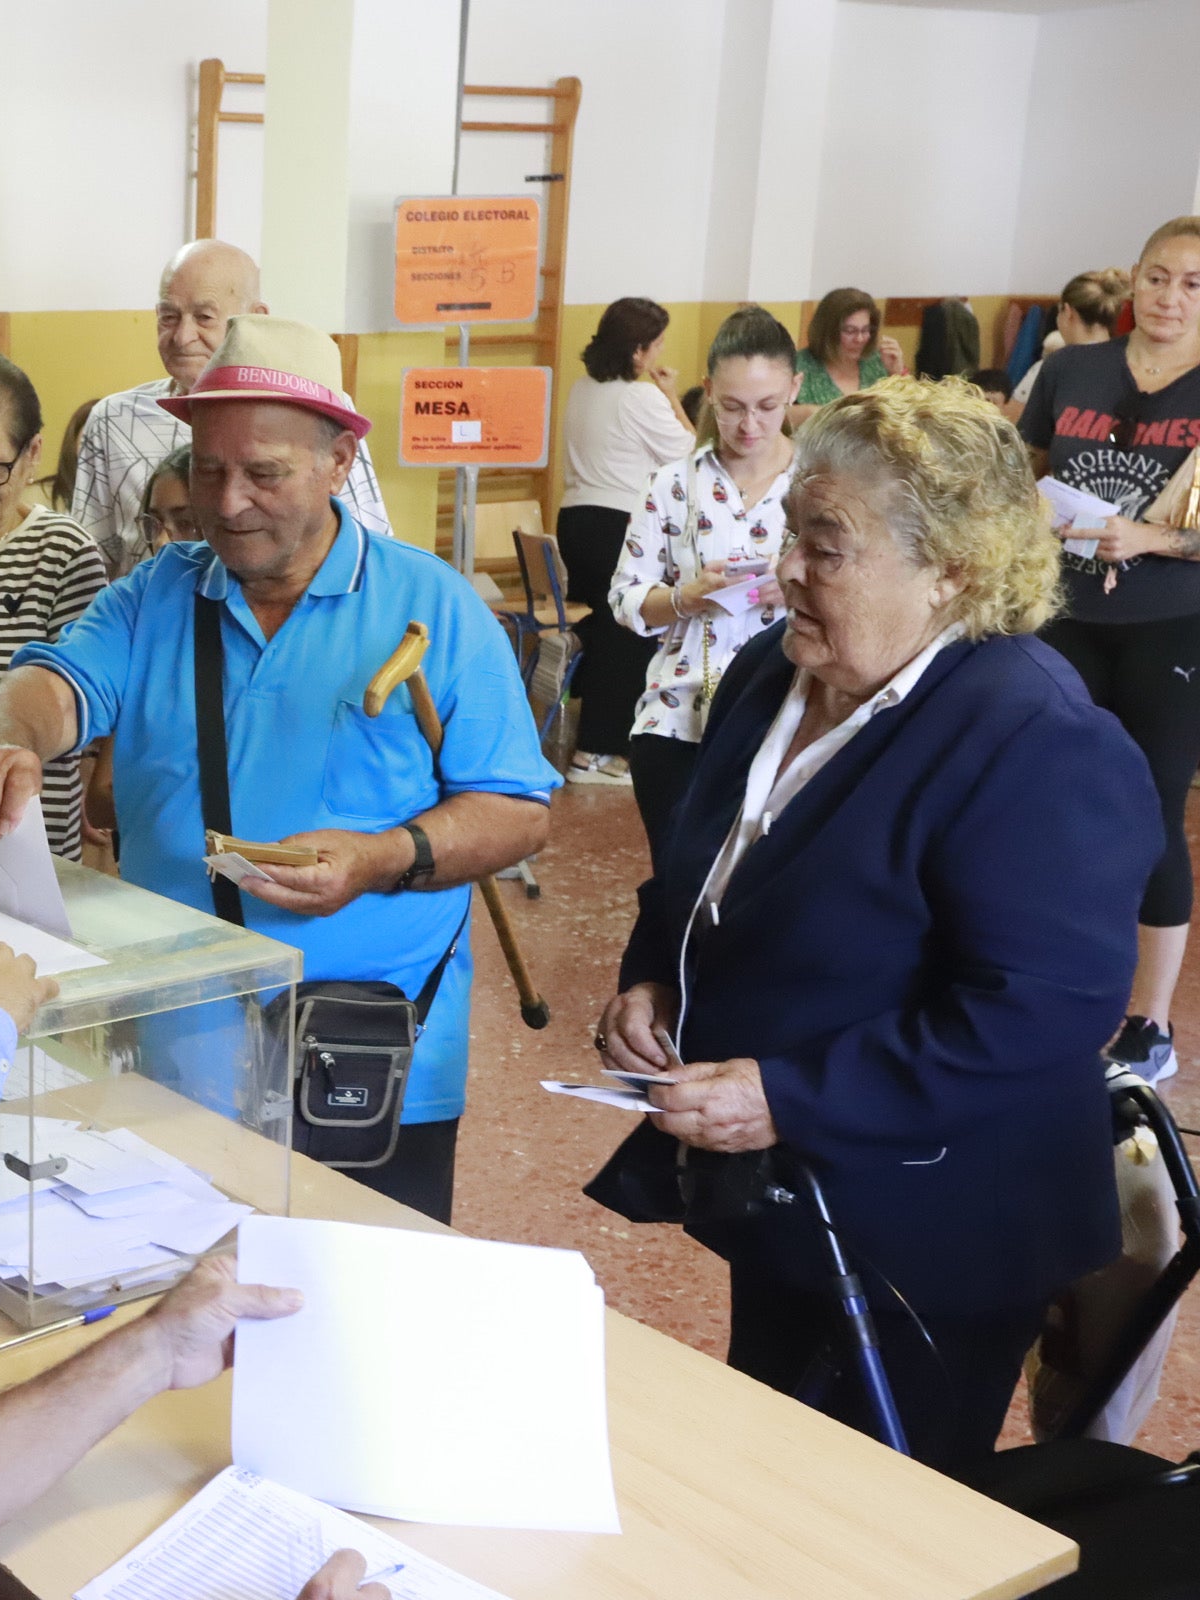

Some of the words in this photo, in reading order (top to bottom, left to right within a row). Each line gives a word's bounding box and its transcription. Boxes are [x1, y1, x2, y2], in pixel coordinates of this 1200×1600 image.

[406, 210, 459, 222] COLEGIO
[463, 210, 531, 221] ELECTORAL
[411, 245, 454, 254] DISTRITO
[410, 272, 461, 281] SECCIONES
[238, 367, 319, 397] BENIDORM
[414, 401, 470, 416] MESA
[1055, 406, 1200, 447] RAMNES
[1068, 450, 1169, 482] JOHNNY
